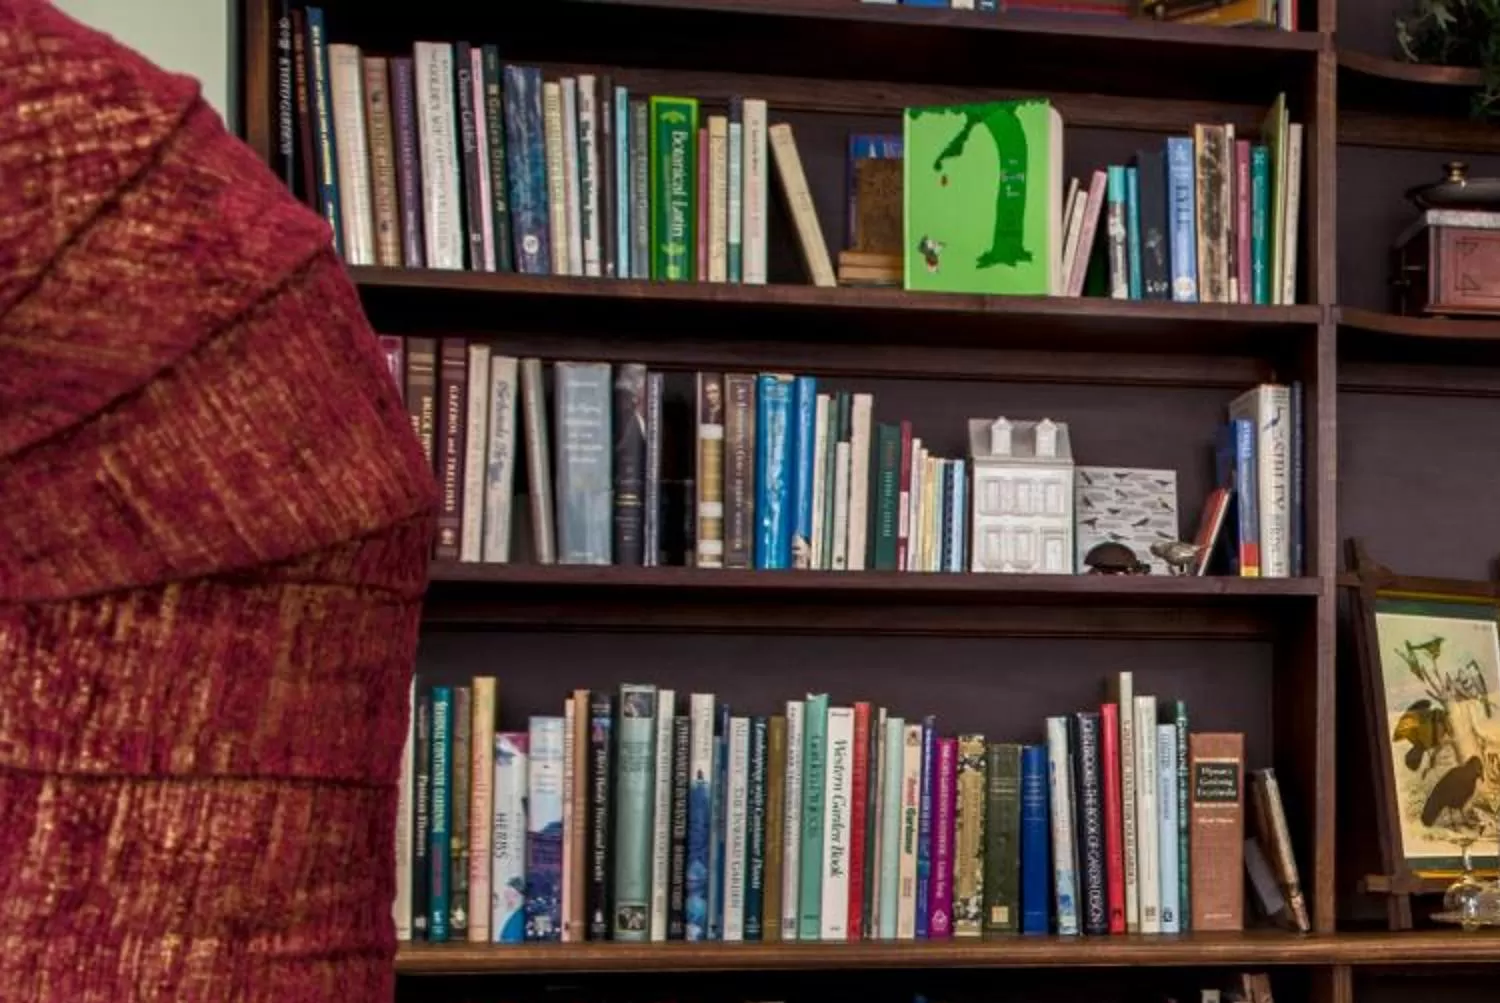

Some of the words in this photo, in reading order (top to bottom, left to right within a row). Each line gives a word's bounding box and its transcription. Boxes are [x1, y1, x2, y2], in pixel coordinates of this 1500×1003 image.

[671, 131, 689, 196] Botanical
[671, 200, 689, 238] Latin
[447, 385, 459, 434] GAZEBOS
[444, 457, 456, 512] TRELLISES
[832, 739, 849, 791] Western
[495, 813, 508, 859] HERBS
[830, 794, 846, 842] Garden
[1086, 807, 1098, 834] BOOK
[829, 845, 845, 879] Book
[1088, 851, 1100, 888] GARDEN
[1089, 889, 1102, 922] DESIGN
